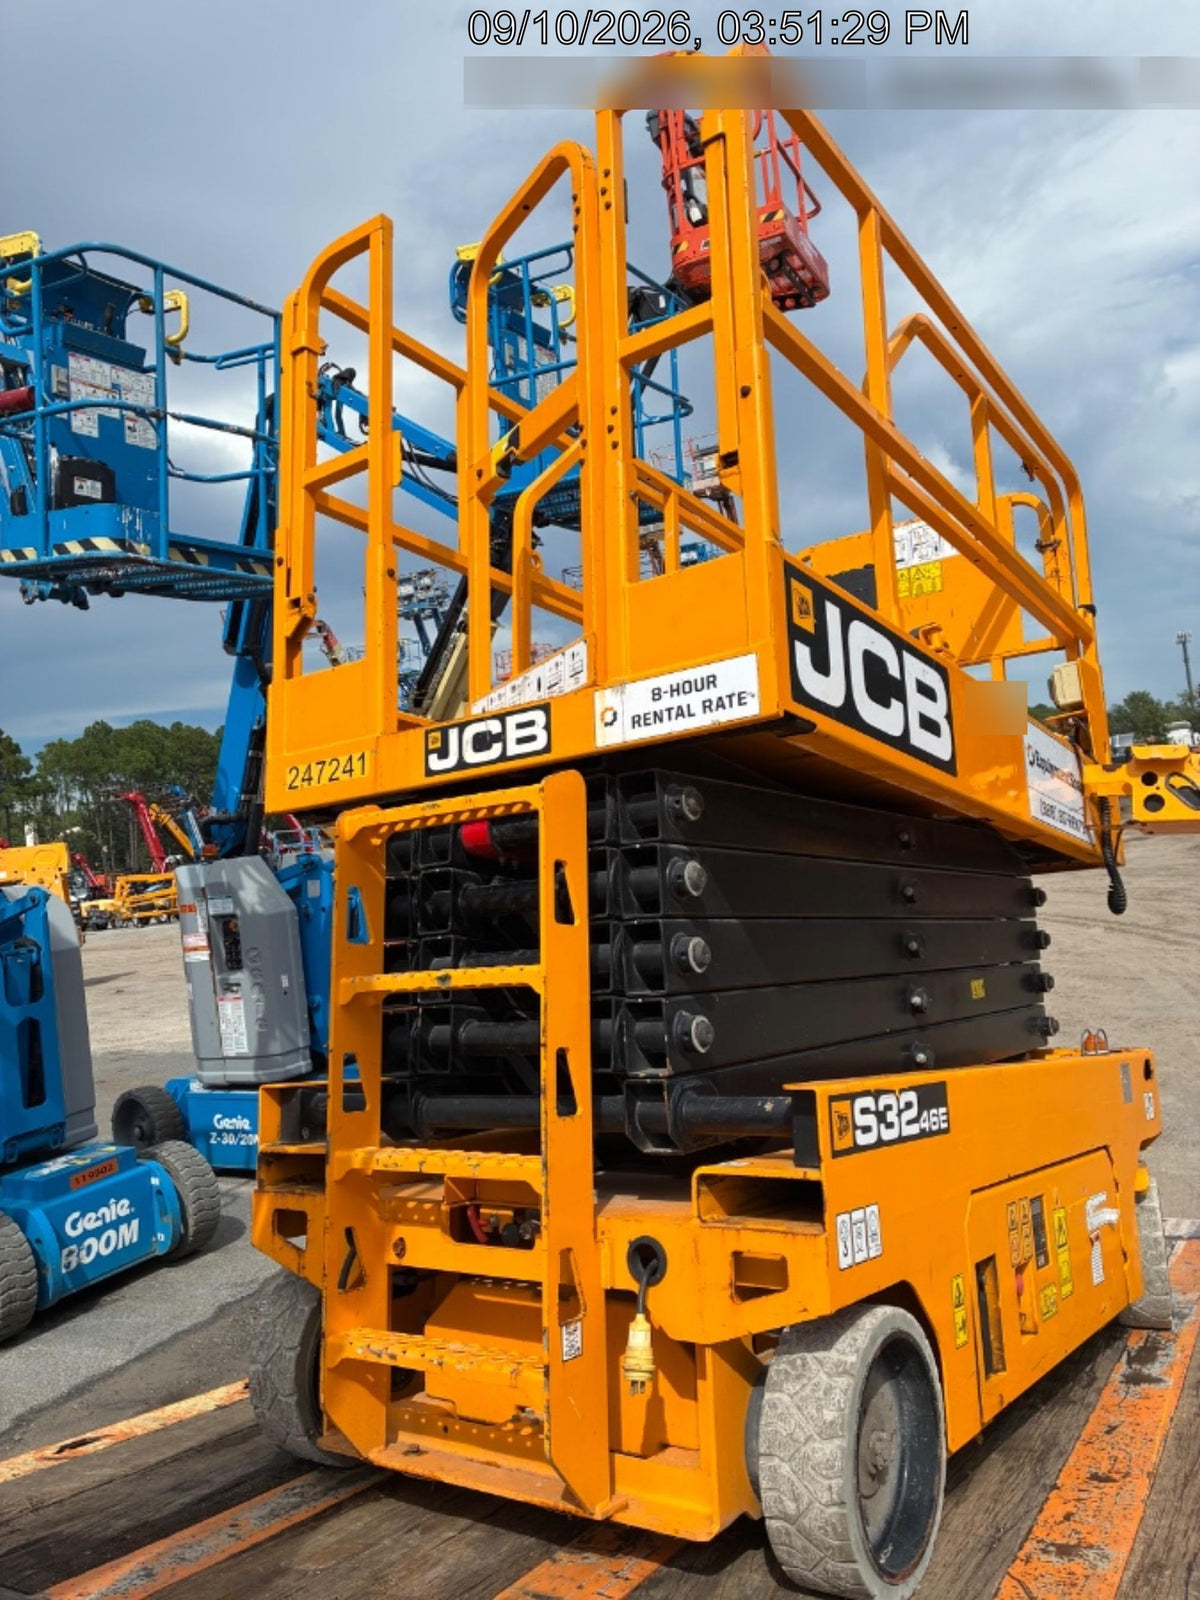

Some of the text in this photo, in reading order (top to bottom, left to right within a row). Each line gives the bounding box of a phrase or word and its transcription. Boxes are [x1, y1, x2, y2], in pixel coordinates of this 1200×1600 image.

[651, 674, 718, 702] 8-HOUR
[794, 600, 953, 762] JCB
[631, 703, 696, 729] RENTAL
[427, 709, 549, 771] JCB
[287, 751, 365, 790] 247241
[213, 1114, 250, 1130] Genie
[65, 1197, 131, 1238] Genie
[61, 1218, 140, 1274] BOOM
